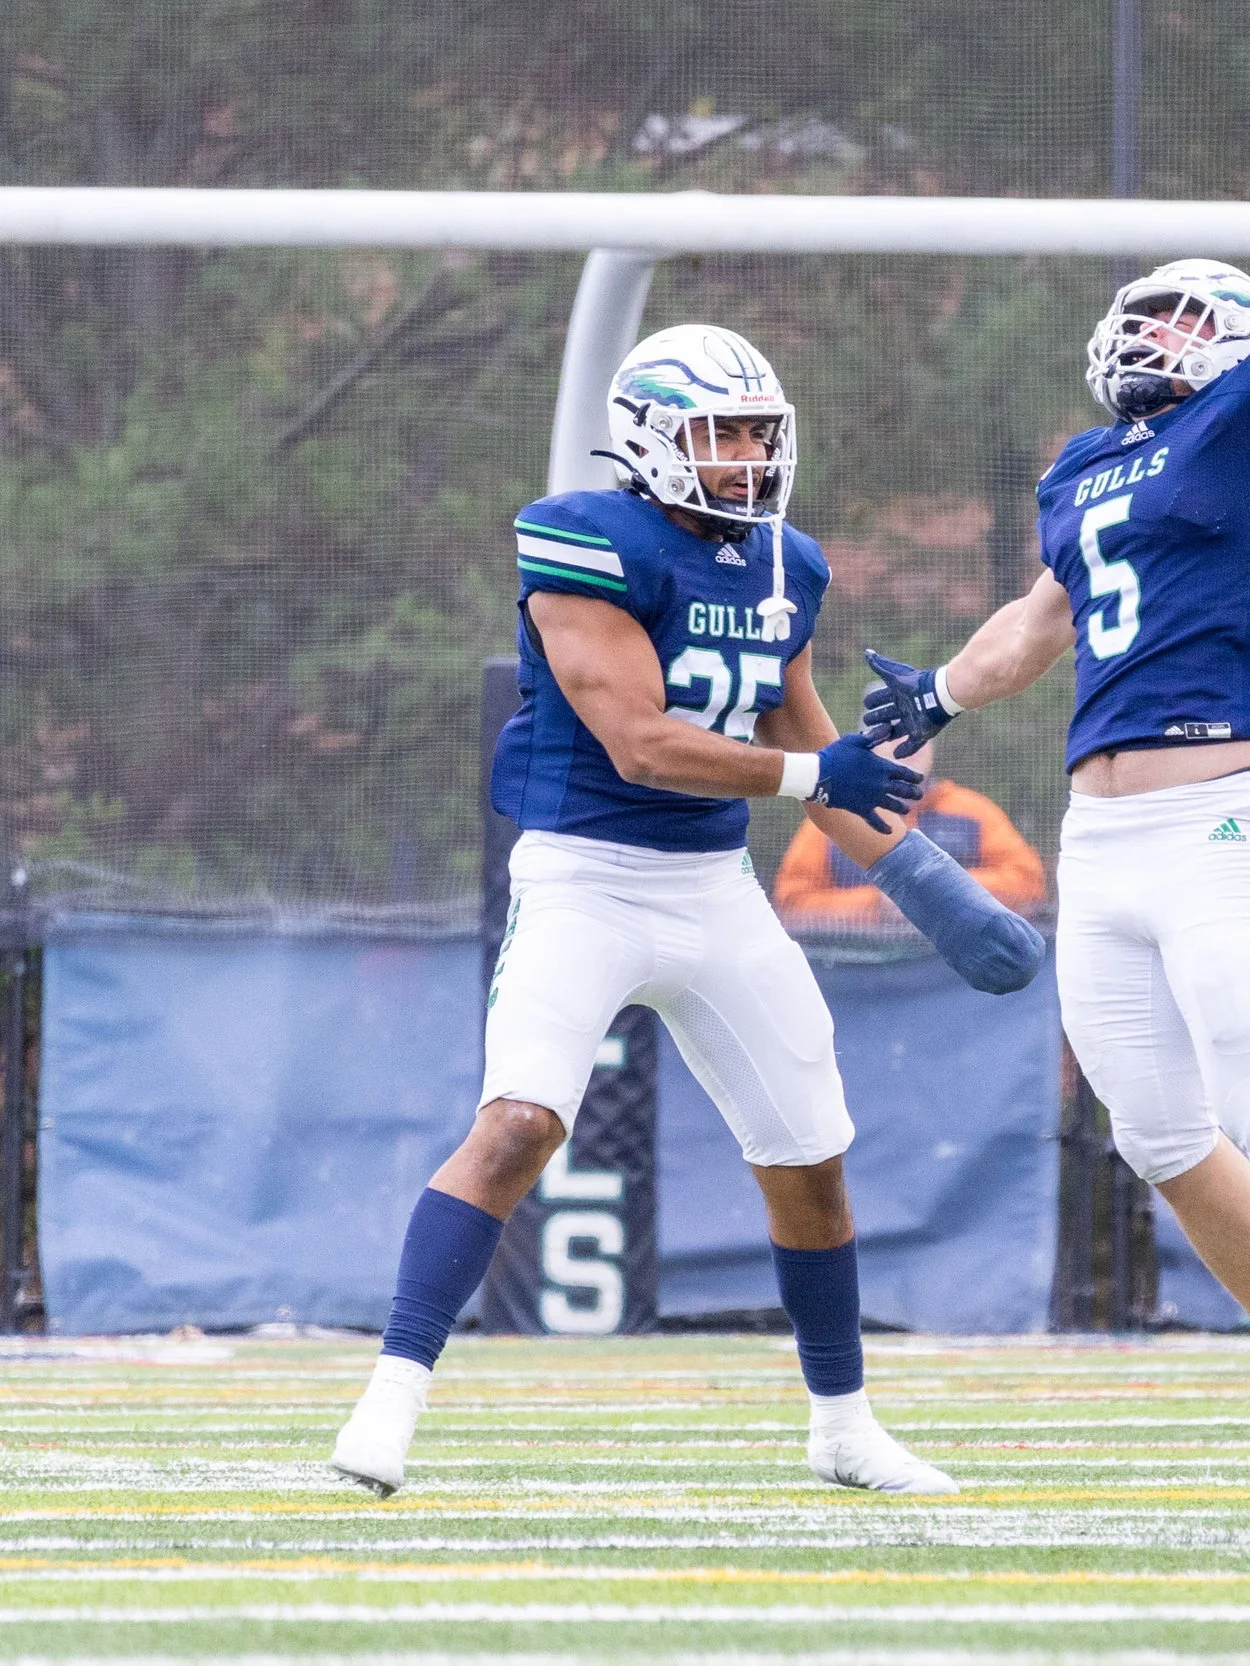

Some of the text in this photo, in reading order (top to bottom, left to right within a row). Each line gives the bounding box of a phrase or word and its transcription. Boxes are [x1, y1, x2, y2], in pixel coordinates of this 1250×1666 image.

[1074, 446, 1170, 507] GULLS
[714, 555, 747, 567] adidas
[1079, 493, 1142, 661] 5
[687, 601, 762, 641] GULL
[664, 645, 783, 744] 25
[1208, 831, 1247, 842] adidas
